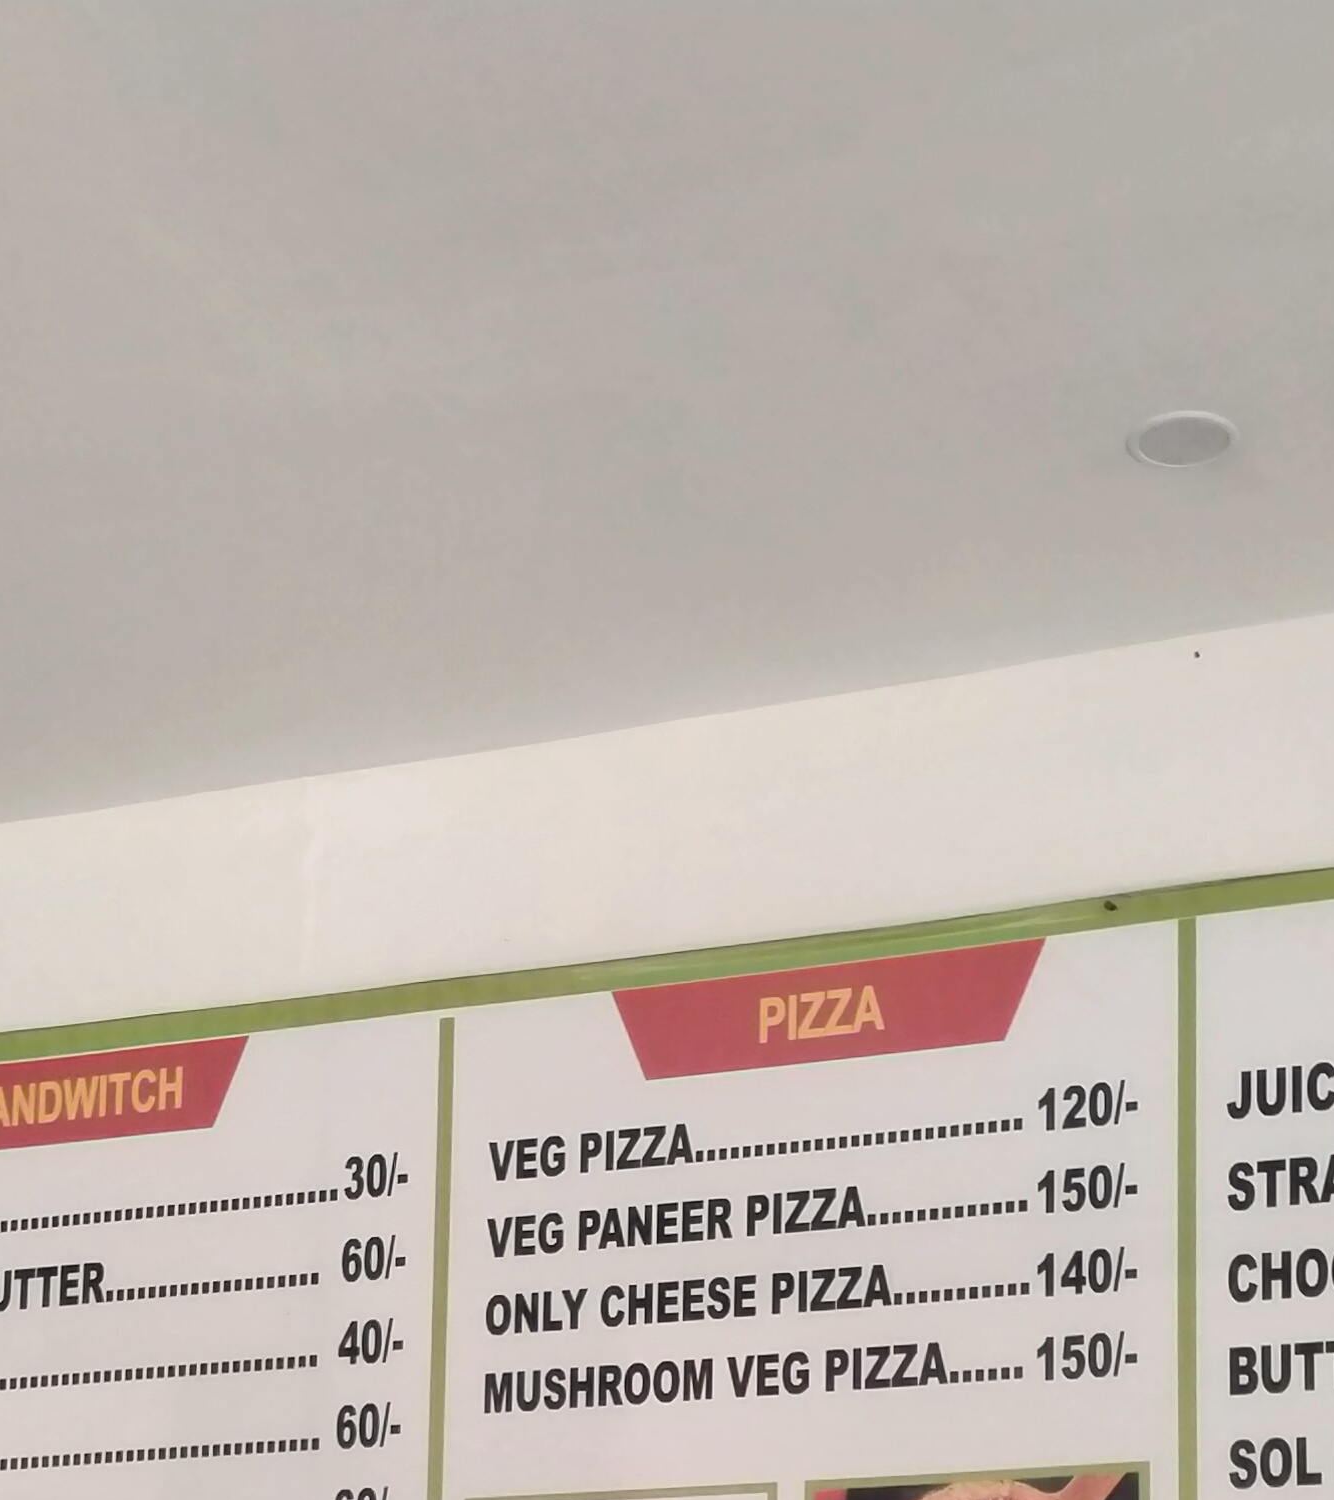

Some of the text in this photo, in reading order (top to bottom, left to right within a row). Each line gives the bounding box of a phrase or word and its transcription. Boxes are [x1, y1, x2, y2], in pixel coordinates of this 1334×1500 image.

[759, 985, 885, 1044] PIZZA
[488, 1136, 566, 1182] VEG
[1038, 1079, 1139, 1132] 120/-
[343, 1151, 409, 1201] 30/-
[486, 1214, 564, 1258] VEG
[577, 1198, 733, 1251] PANEER
[1037, 1162, 1138, 1214] 150/-
[341, 1235, 407, 1283] 60/-
[485, 1288, 588, 1336] ONLY
[600, 1274, 757, 1328] CHEESE
[1037, 1246, 1138, 1297] 140/-
[337, 1317, 404, 1365] 40/-
[483, 1358, 714, 1414] MUSHROOM
[727, 1351, 810, 1398] VEG
[1036, 1330, 1138, 1381] 150/-
[336, 1402, 401, 1450] 60/-
[1228, 1438, 1323, 1490] SOL
